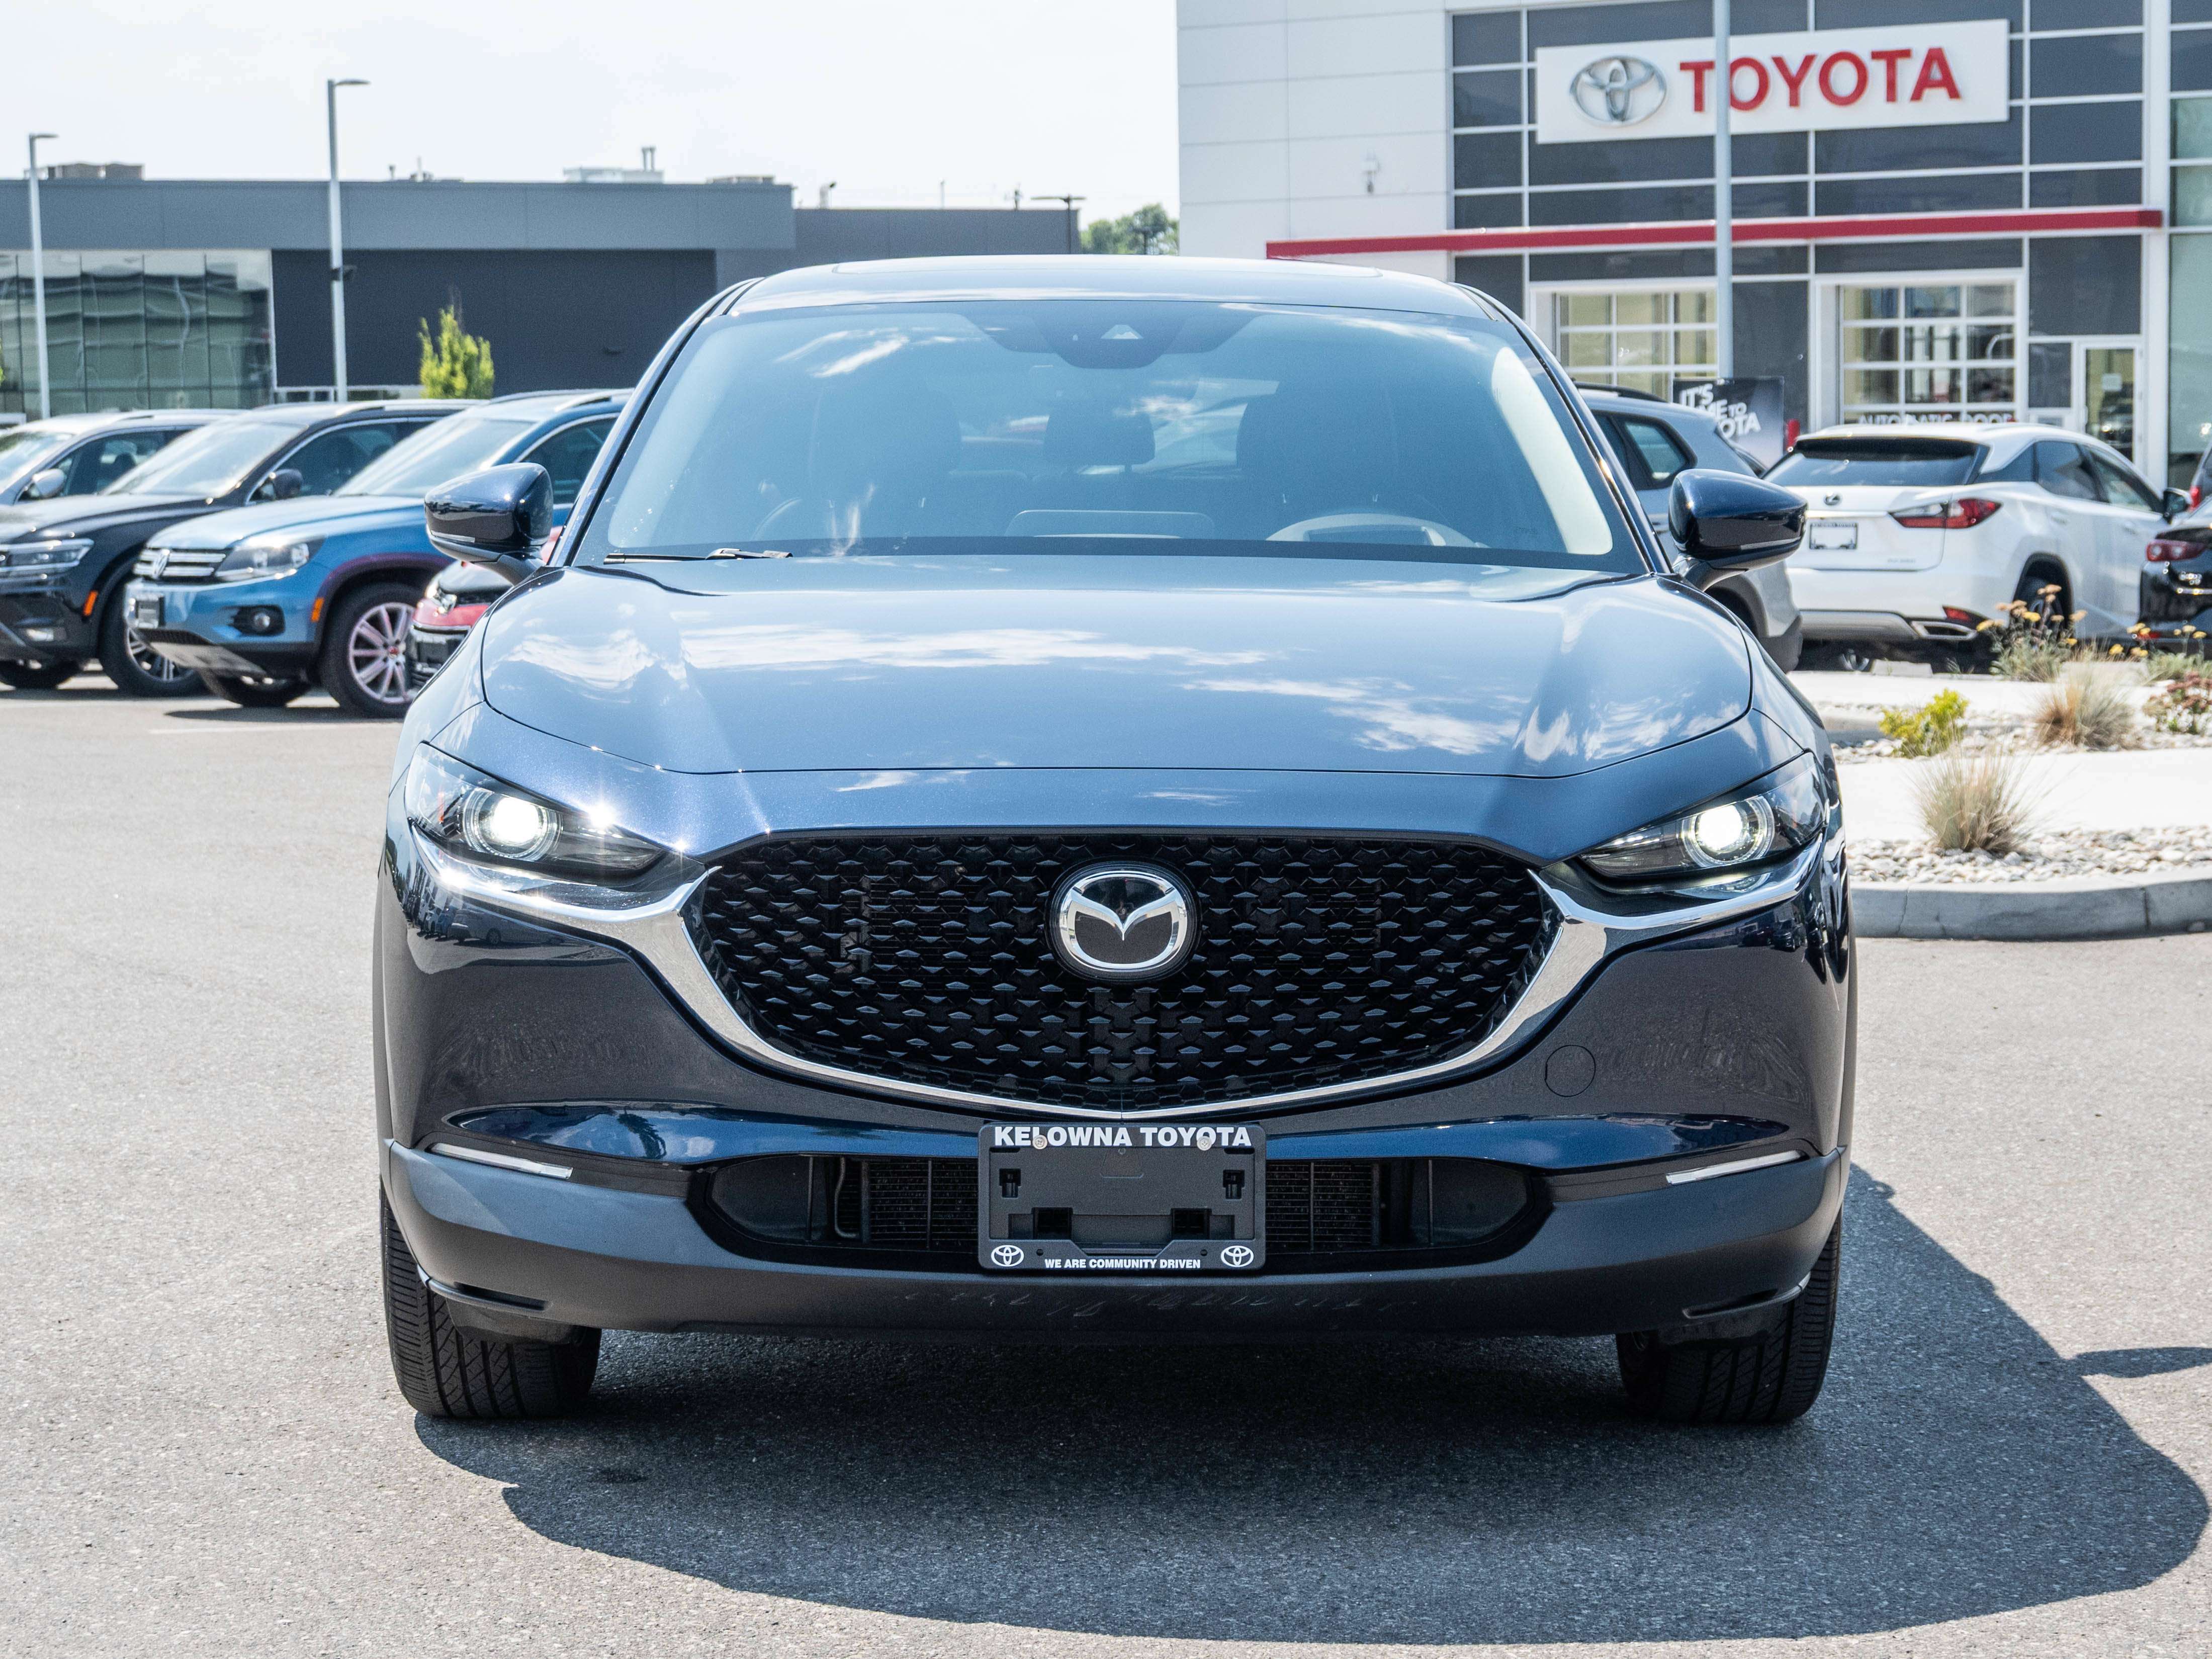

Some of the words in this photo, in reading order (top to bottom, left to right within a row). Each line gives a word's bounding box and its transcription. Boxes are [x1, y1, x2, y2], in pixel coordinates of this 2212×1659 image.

[1679, 47, 1962, 113] TOYOTA
[1680, 383, 1714, 408] IT'S
[1728, 402, 1747, 417] TO
[1140, 1126, 1252, 1147] TOYOTA
[1044, 1259, 1062, 1268] WE
[1064, 1259, 1086, 1268] ARE
[1089, 1259, 1157, 1268] COMMUNITY
[1160, 1259, 1201, 1268] DRIVEN
